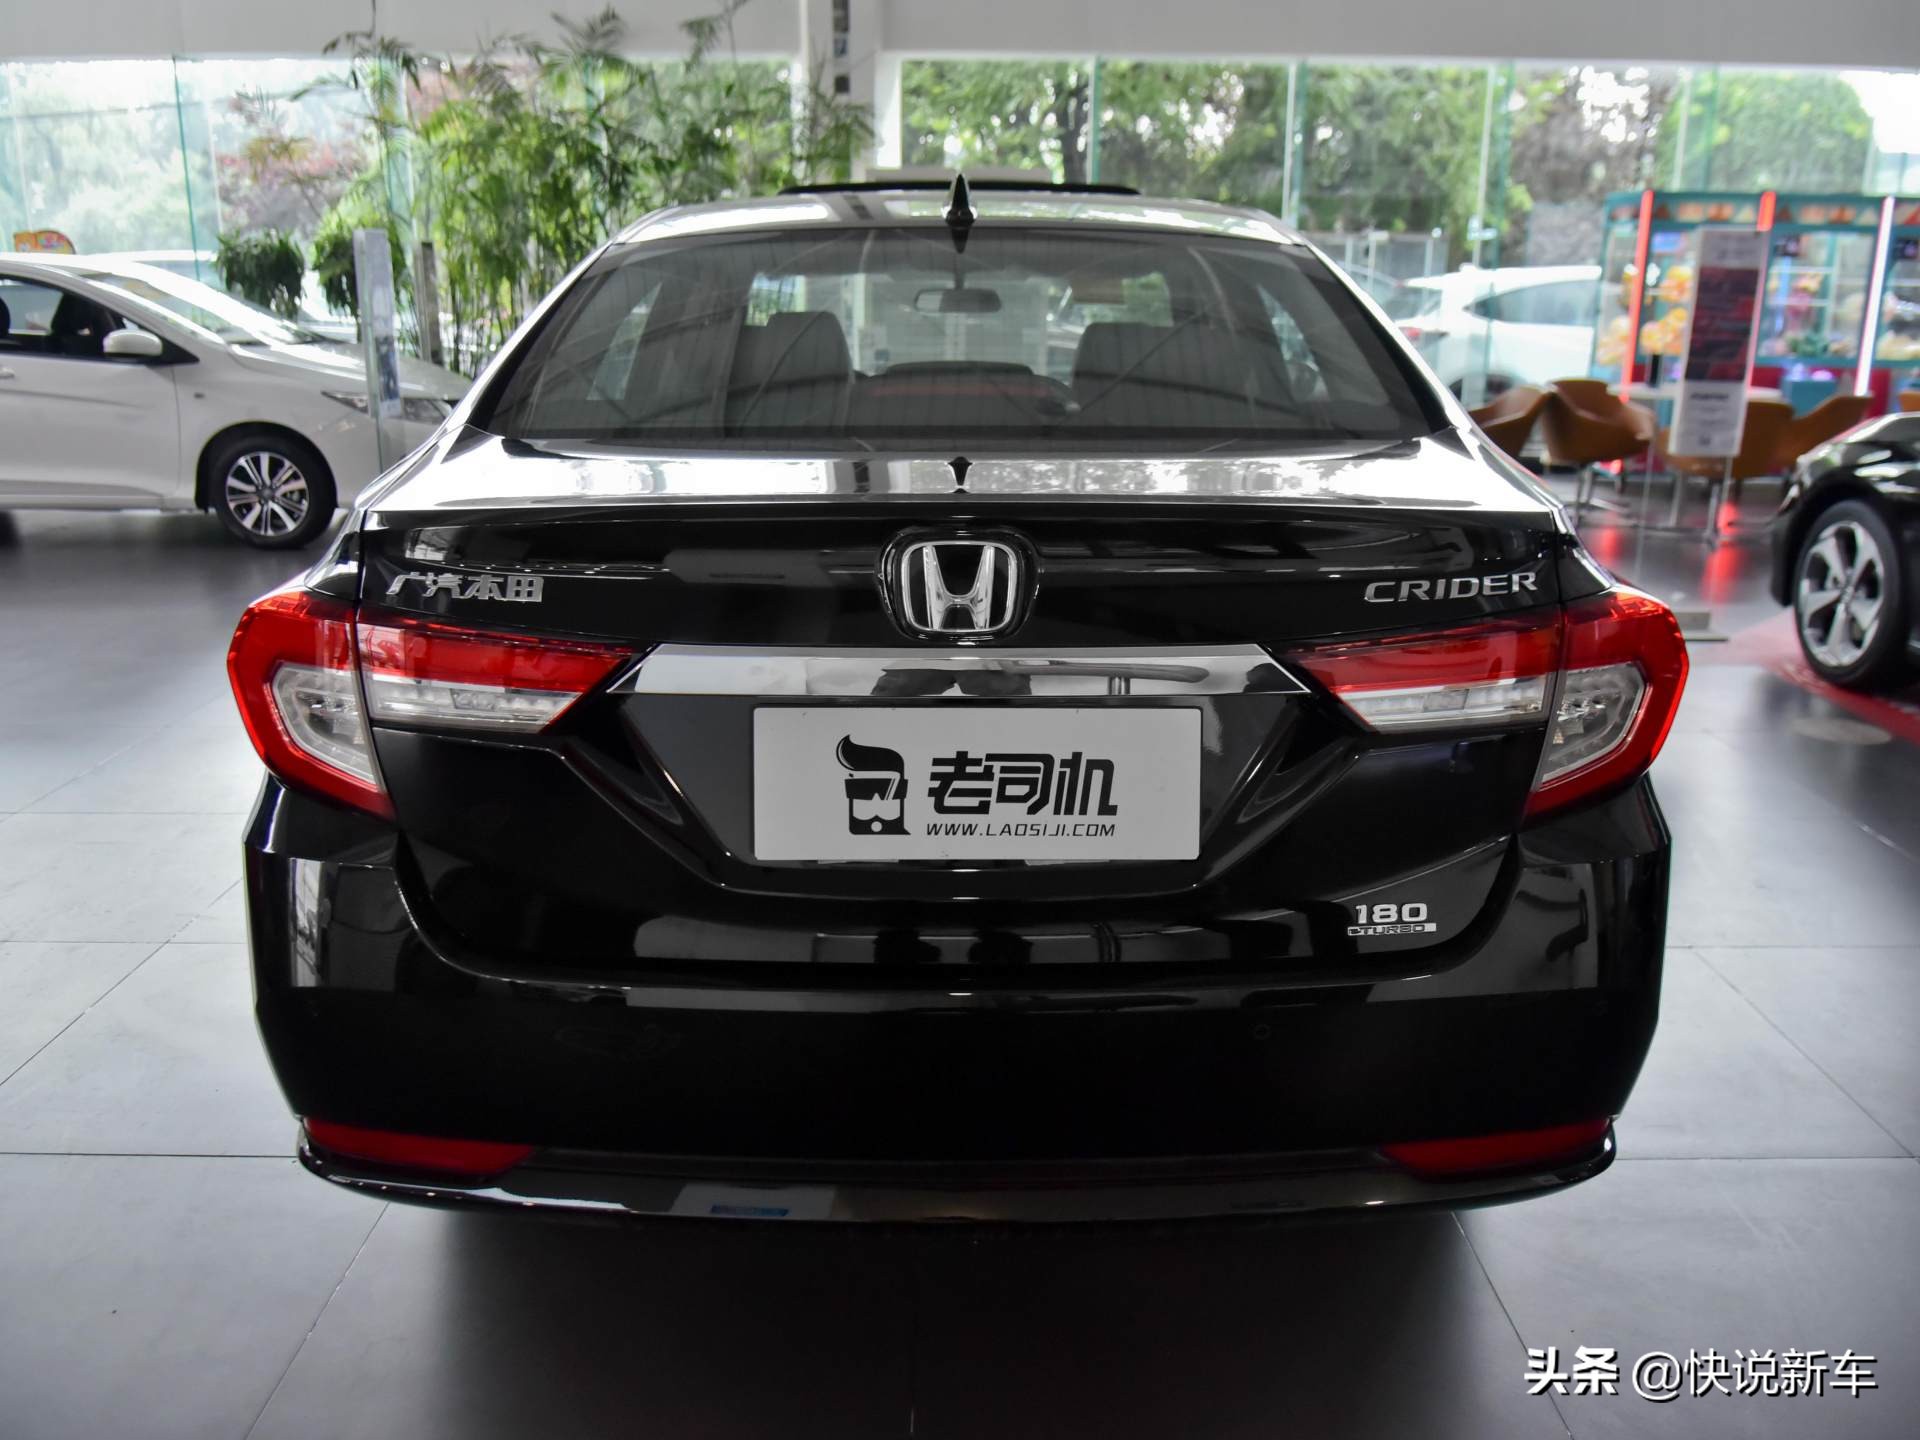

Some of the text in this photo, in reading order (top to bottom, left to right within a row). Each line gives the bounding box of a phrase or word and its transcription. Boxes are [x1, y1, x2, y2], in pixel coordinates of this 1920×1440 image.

[385, 571, 545, 603] 广汽本田
[1364, 571, 1538, 603] CRIDER
[927, 750, 1119, 817] 老司机
[925, 822, 1116, 838] WWW.LAOSIJI.COM
[1355, 902, 1428, 925] 180
